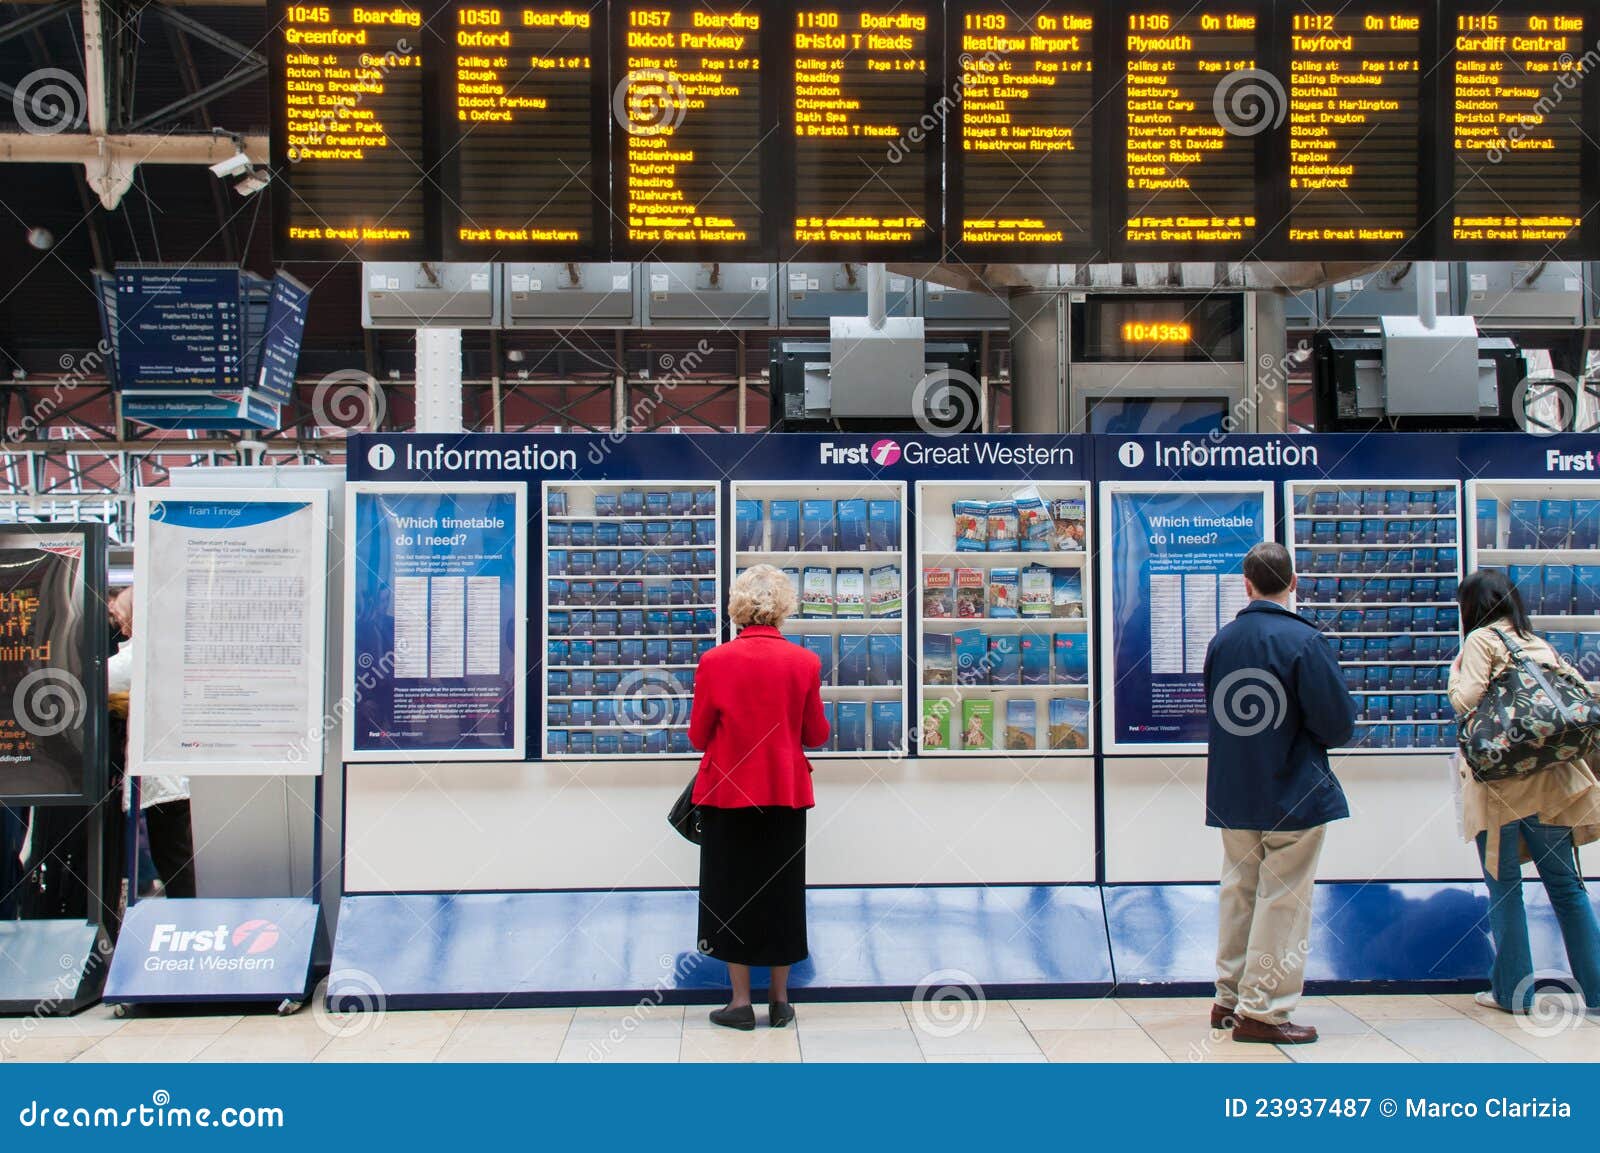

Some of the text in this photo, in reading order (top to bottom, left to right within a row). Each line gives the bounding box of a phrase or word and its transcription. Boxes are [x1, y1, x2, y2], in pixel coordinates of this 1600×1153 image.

[288, 8, 420, 25] 10:45 Boarding
[458, 10, 590, 27] 10:50 Boarding
[630, 12, 759, 29] 10:57 Boarding
[798, 13, 926, 30] 11:00 Boarding
[966, 15, 1092, 30] 11:03 On time
[1129, 15, 1255, 29] 11:06 On time
[1293, 16, 1419, 30] 11:12 On time
[1458, 16, 1583, 30] 11:15 On time
[286, 28, 366, 44] Greenford
[458, 31, 510, 46] Oxford
[628, 32, 744, 50] Didcot Parkway
[796, 33, 912, 50] Bristol T Meads
[963, 36, 1079, 52] Heathrow Airport
[1128, 36, 1191, 52] Plymouth
[1292, 36, 1352, 52] Twyford
[1456, 36, 1566, 51] Cardiff Central
[458, 56, 490, 68] Calling
[493, 57, 507, 67] at:
[532, 57, 555, 68] Page
[568, 58, 580, 68] of
[287, 68, 380, 79] Acton Main Line
[458, 70, 497, 81] Slough
[1128, 74, 1167, 84] Pewsey
[1291, 74, 1382, 84] Ealing Broadway
[458, 83, 504, 95] Reading
[796, 85, 840, 96] Swindon
[1128, 87, 1178, 98] Westbury
[458, 96, 546, 108] Didcot Parkway
[796, 98, 859, 110] Chippenham
[964, 101, 1005, 110] Hanwell
[1128, 100, 1194, 111] Castle Cary
[1291, 100, 1324, 111] Hayes
[1339, 100, 1398, 111] Harlington
[796, 112, 846, 123] Bath Spa
[964, 114, 1010, 124] Southall
[1128, 113, 1172, 123] Taunton
[1291, 113, 1365, 123] West Drayton
[288, 122, 382, 132] Castle Bar Park
[1455, 126, 1498, 136] Newport
[288, 135, 386, 146] South Greenford
[1127, 139, 1223, 149] Exeter St Davids
[1291, 139, 1336, 149] Burnham
[629, 150, 693, 161] Maidenhead
[1127, 152, 1201, 162] Newton Abbot
[1291, 152, 1328, 162] Taplow
[1128, 165, 1165, 175] Totnes
[629, 190, 683, 200] Tilehurst
[629, 203, 696, 214] Pangbourne
[290, 227, 410, 240] First Great Western
[963, 231, 1062, 241] Heathrow Connect
[175, 366, 215, 374] Underground
[166, 403, 203, 412] Paddington
[407, 443, 577, 470] Information
[820, 442, 1073, 465] First Great Western
[1155, 441, 1318, 467] Information
[1546, 449, 1595, 471] First
[188, 506, 241, 516] Train Times
[395, 517, 505, 529] Which timetable
[1149, 515, 1254, 527] Which timetable
[396, 534, 468, 546] do I need?
[1150, 533, 1166, 544] do
[1178, 532, 1218, 544] need?
[149, 924, 229, 952] First
[144, 956, 275, 971] Great Western
